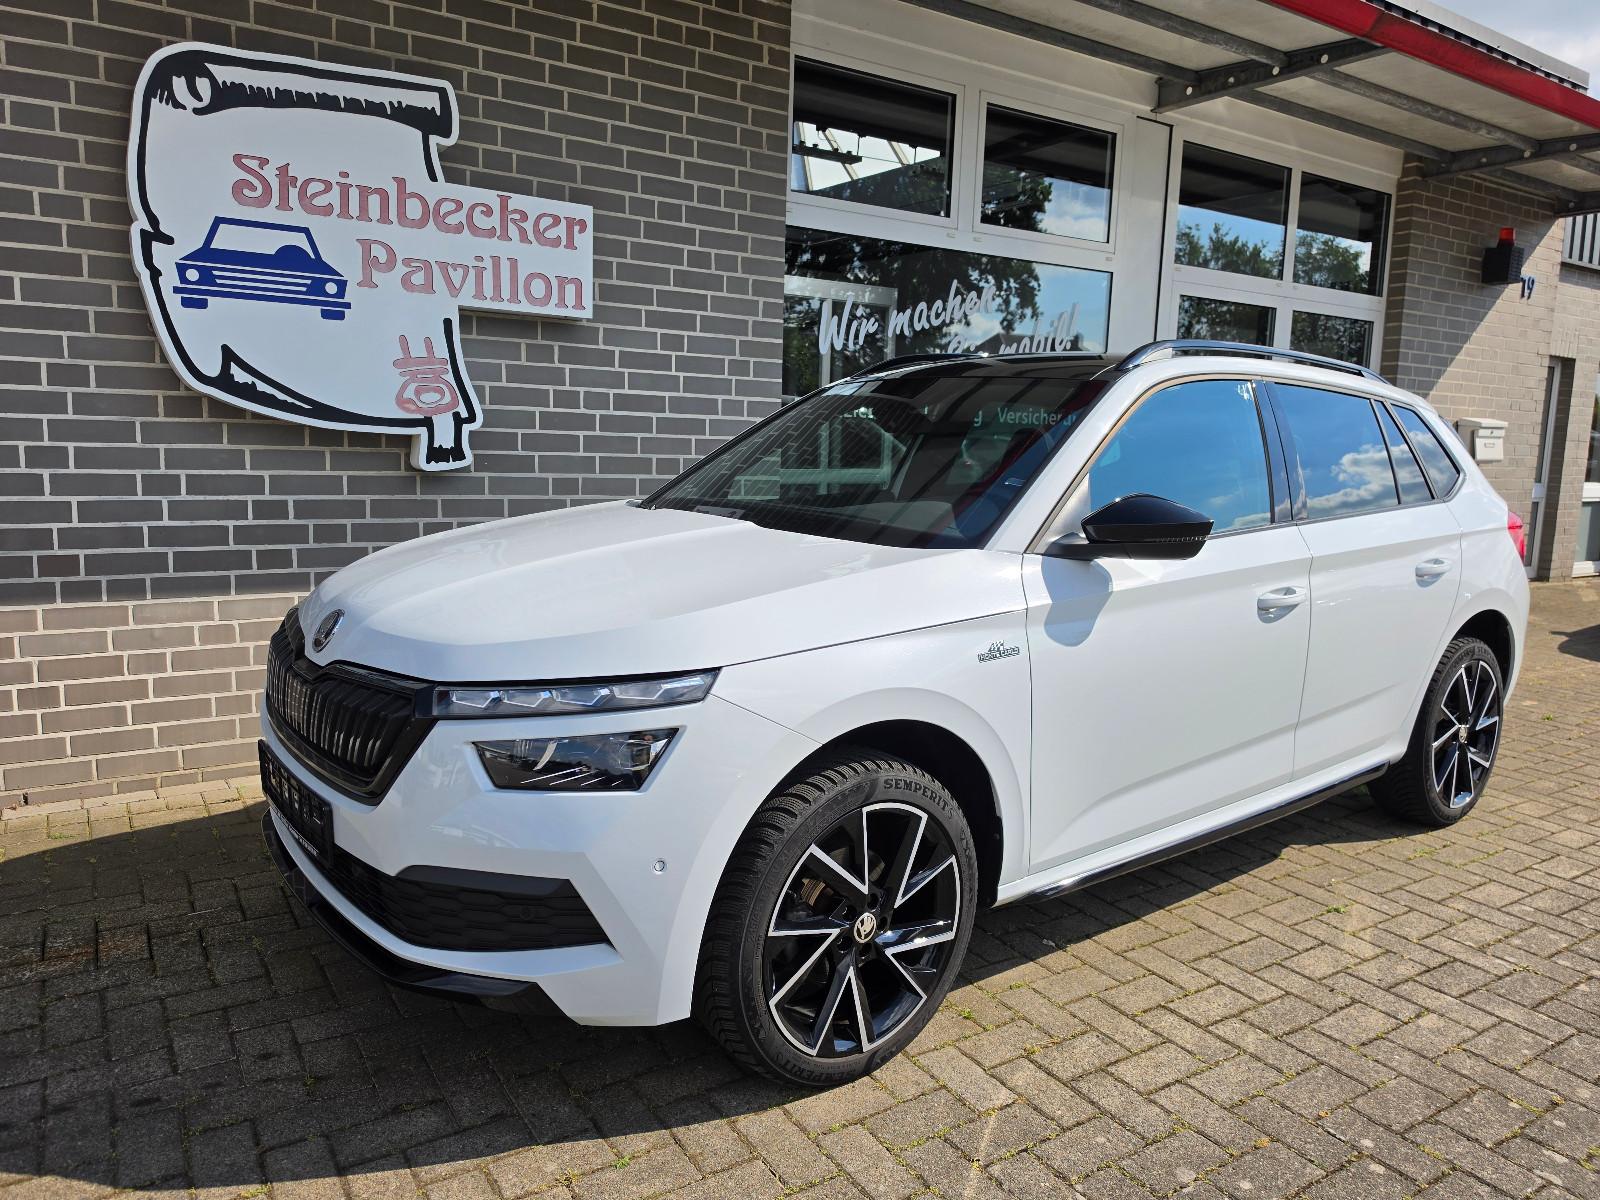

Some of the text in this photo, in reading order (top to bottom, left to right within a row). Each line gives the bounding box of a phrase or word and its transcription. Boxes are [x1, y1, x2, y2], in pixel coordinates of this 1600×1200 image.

[231, 152, 588, 252] Steinbecker
[356, 238, 588, 311] Pavillon
[819, 279, 996, 354] Wir machen
[883, 778, 948, 811] SEMPERIT
